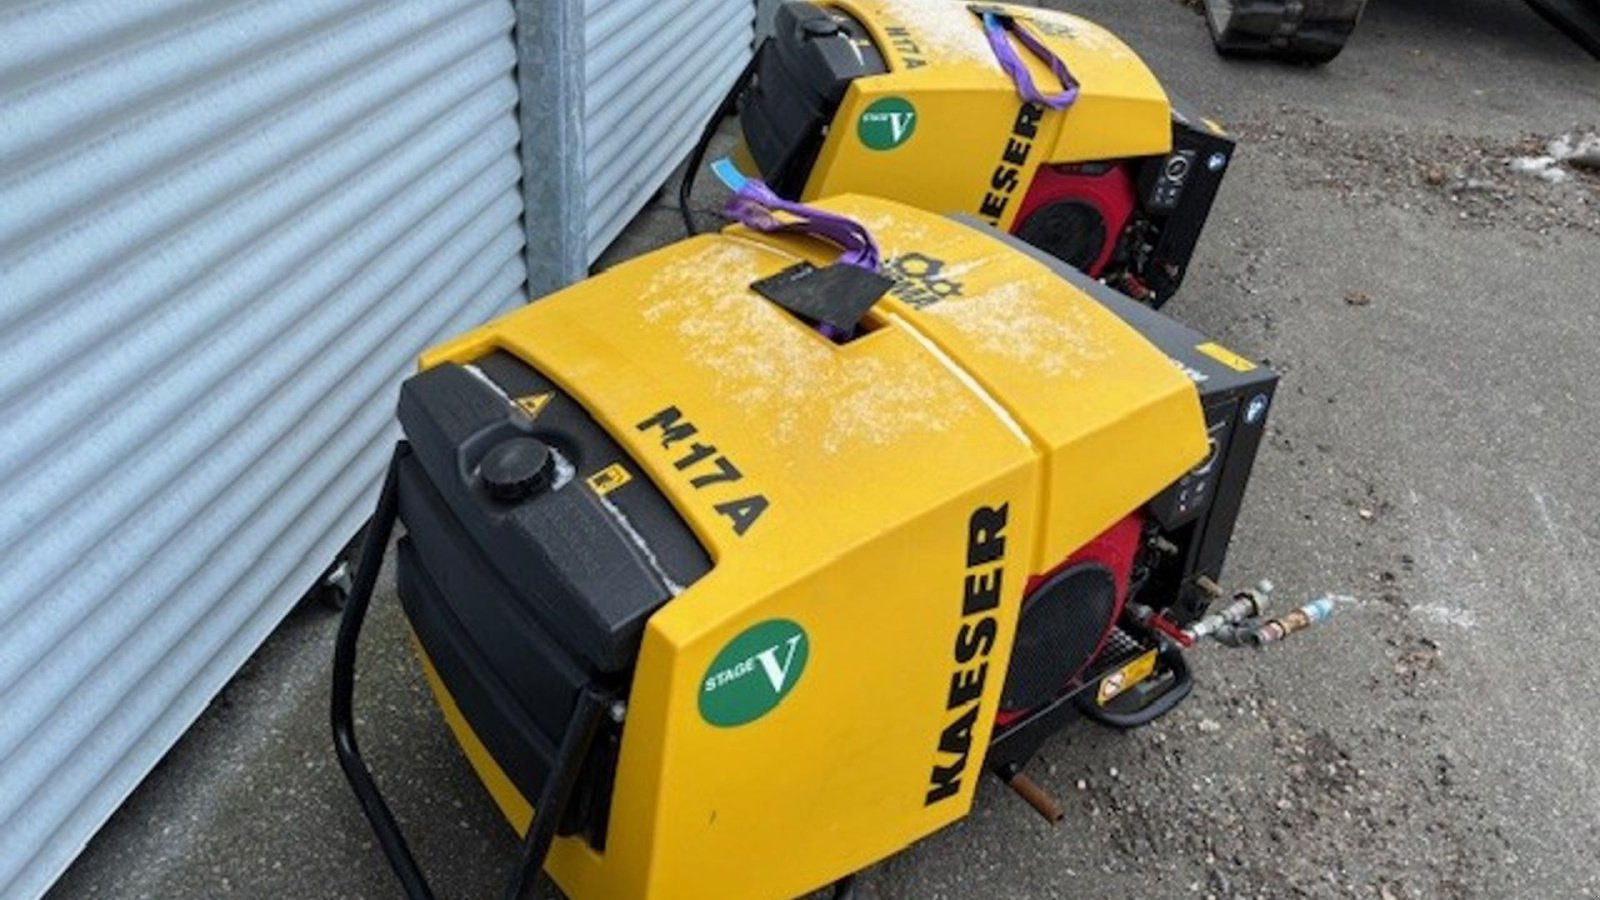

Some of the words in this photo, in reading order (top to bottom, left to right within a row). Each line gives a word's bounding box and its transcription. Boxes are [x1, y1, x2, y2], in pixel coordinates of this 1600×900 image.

[889, 112, 914, 143] V
[979, 102, 1044, 227] ESER
[636, 405, 744, 489] M17
[713, 494, 771, 537] A
[704, 656, 756, 692] STAGE
[756, 634, 802, 694] V
[924, 502, 1010, 806] KAESER
